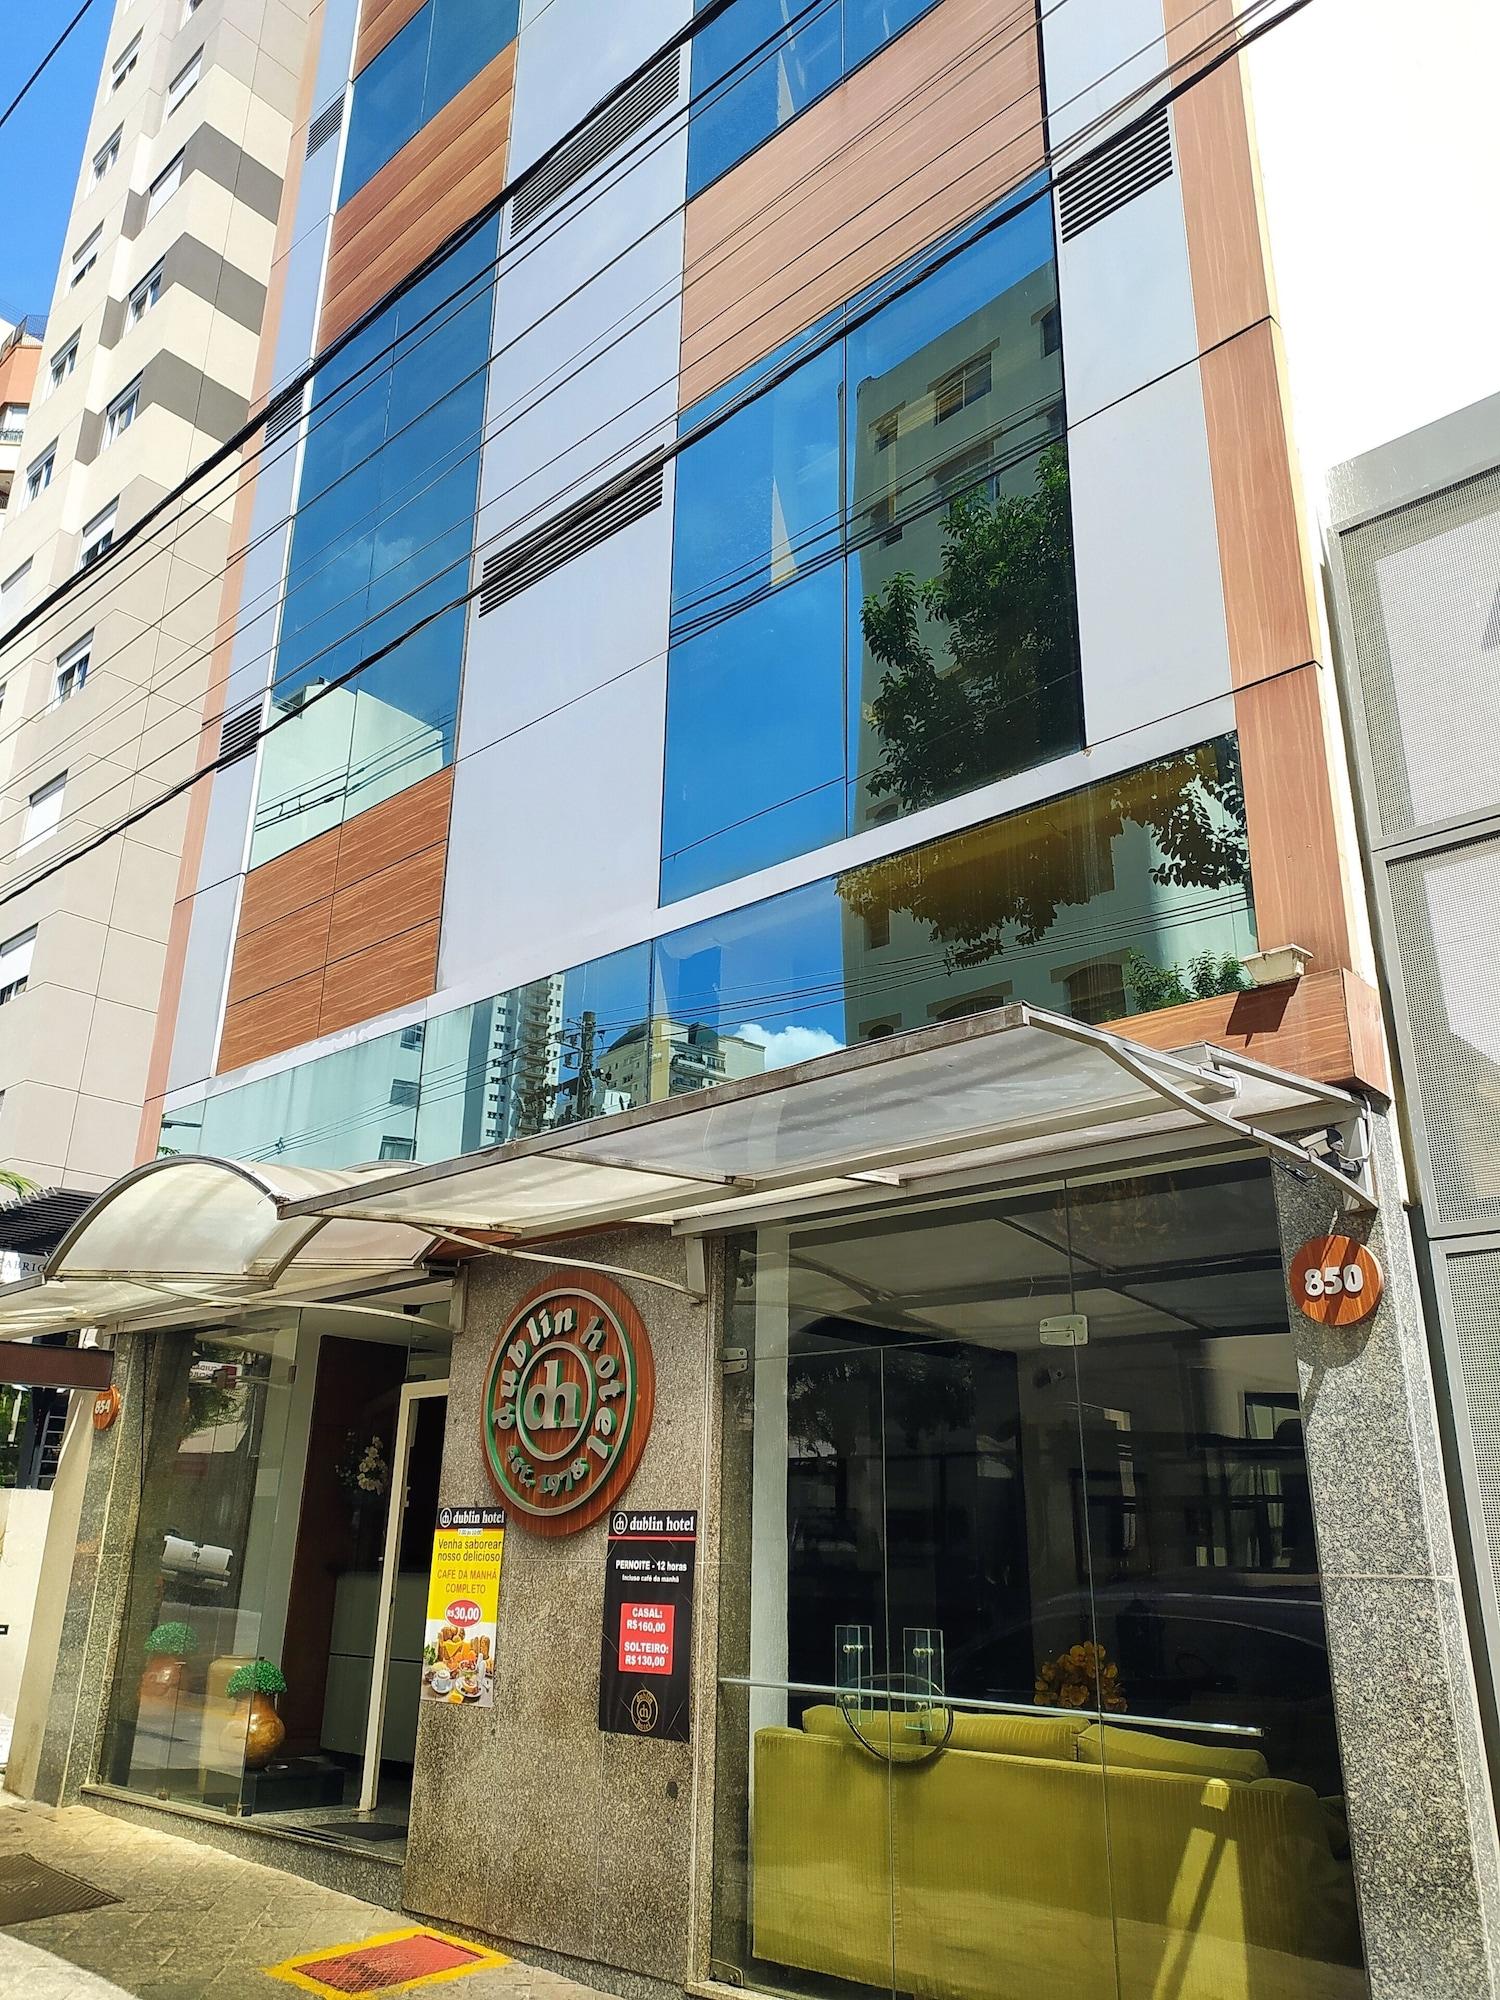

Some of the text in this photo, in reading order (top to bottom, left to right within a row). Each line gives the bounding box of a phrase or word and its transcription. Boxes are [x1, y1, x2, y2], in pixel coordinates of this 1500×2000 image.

[1304, 1264, 1364, 1297] 850
[492, 1307, 625, 1460] dublin hotel
[95, 1399, 111, 1414] 854
[537, 1457, 590, 1497] 1978
[453, 1510, 480, 1524] dublin
[482, 1510, 505, 1524] hotel
[629, 1515, 663, 1531] dublin
[665, 1515, 695, 1532] hotel
[438, 1538, 502, 1550] Venha saborear
[437, 1550, 501, 1562] nosso delicioso
[615, 1559, 651, 1570] PERNOITE
[657, 1561, 666, 1571] 12
[666, 1561, 688, 1572] horas
[458, 1569, 468, 1580] DA
[445, 1583, 486, 1594] COMPLETO
[632, 1607, 663, 1619] CASAL:
[624, 1641, 669, 1654] SOLTEIRO:
